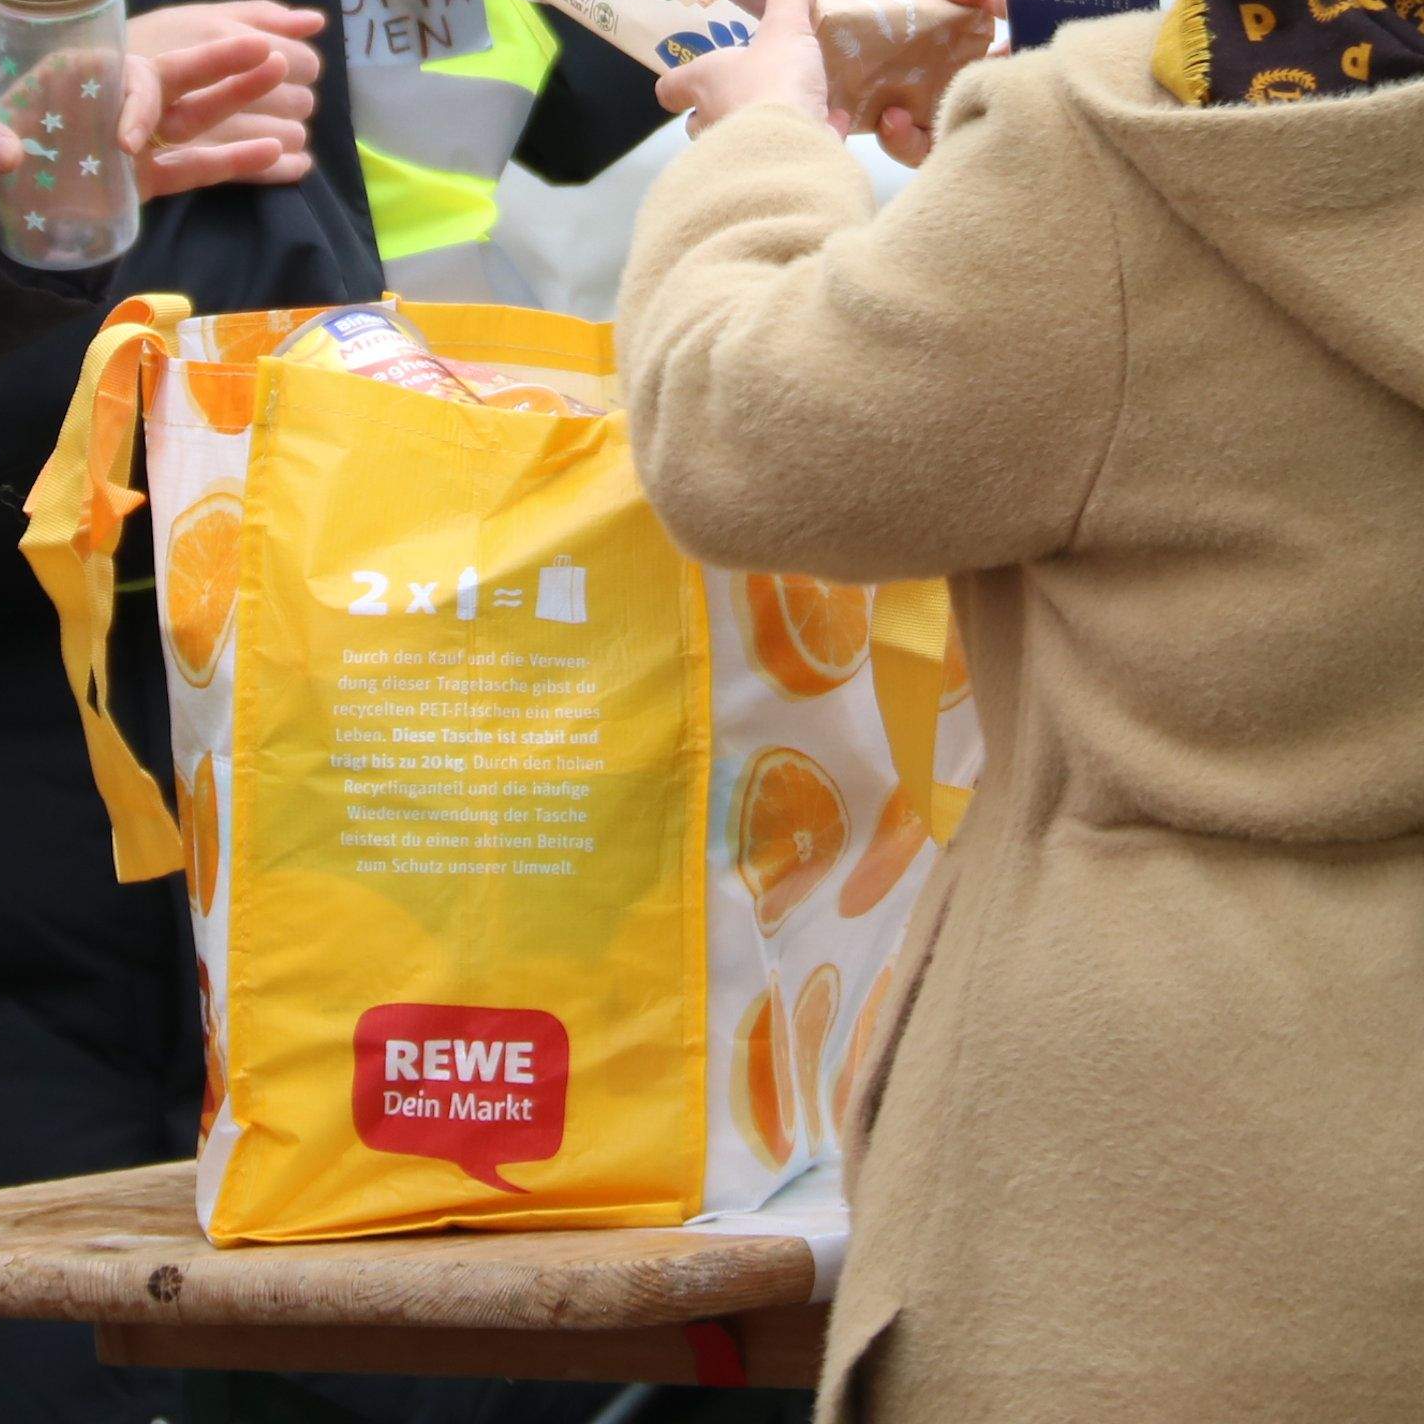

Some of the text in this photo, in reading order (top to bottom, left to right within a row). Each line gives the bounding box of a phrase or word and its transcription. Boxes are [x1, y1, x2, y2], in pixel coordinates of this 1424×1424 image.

[348, 570, 389, 616] 2
[342, 648, 591, 668] Durch den Kauf und die Verwen-
[337, 675, 596, 697] dung dieser Tragetasche gibst du
[332, 700, 600, 720] recycelten PET-Flaschen ein neues
[335, 726, 600, 744] Leben. Diese Tasche ist stabil und
[330, 752, 367, 772] trägt
[371, 752, 395, 769] bis
[398, 755, 417, 769] zu
[472, 753, 519, 770] Durch
[522, 754, 552, 771] den
[556, 755, 604, 772] hohen
[343, 777, 590, 800] Recyclinganteil und die häufige
[346, 804, 588, 826] Wiederverwendung der Tasche
[339, 830, 595, 853] leistest du einen aktiven Beitrag
[355, 857, 577, 875] zum Schutz unserer Umwelt.
[384, 1040, 534, 1084] REWE
[383, 1089, 533, 1121] Dein Markt
